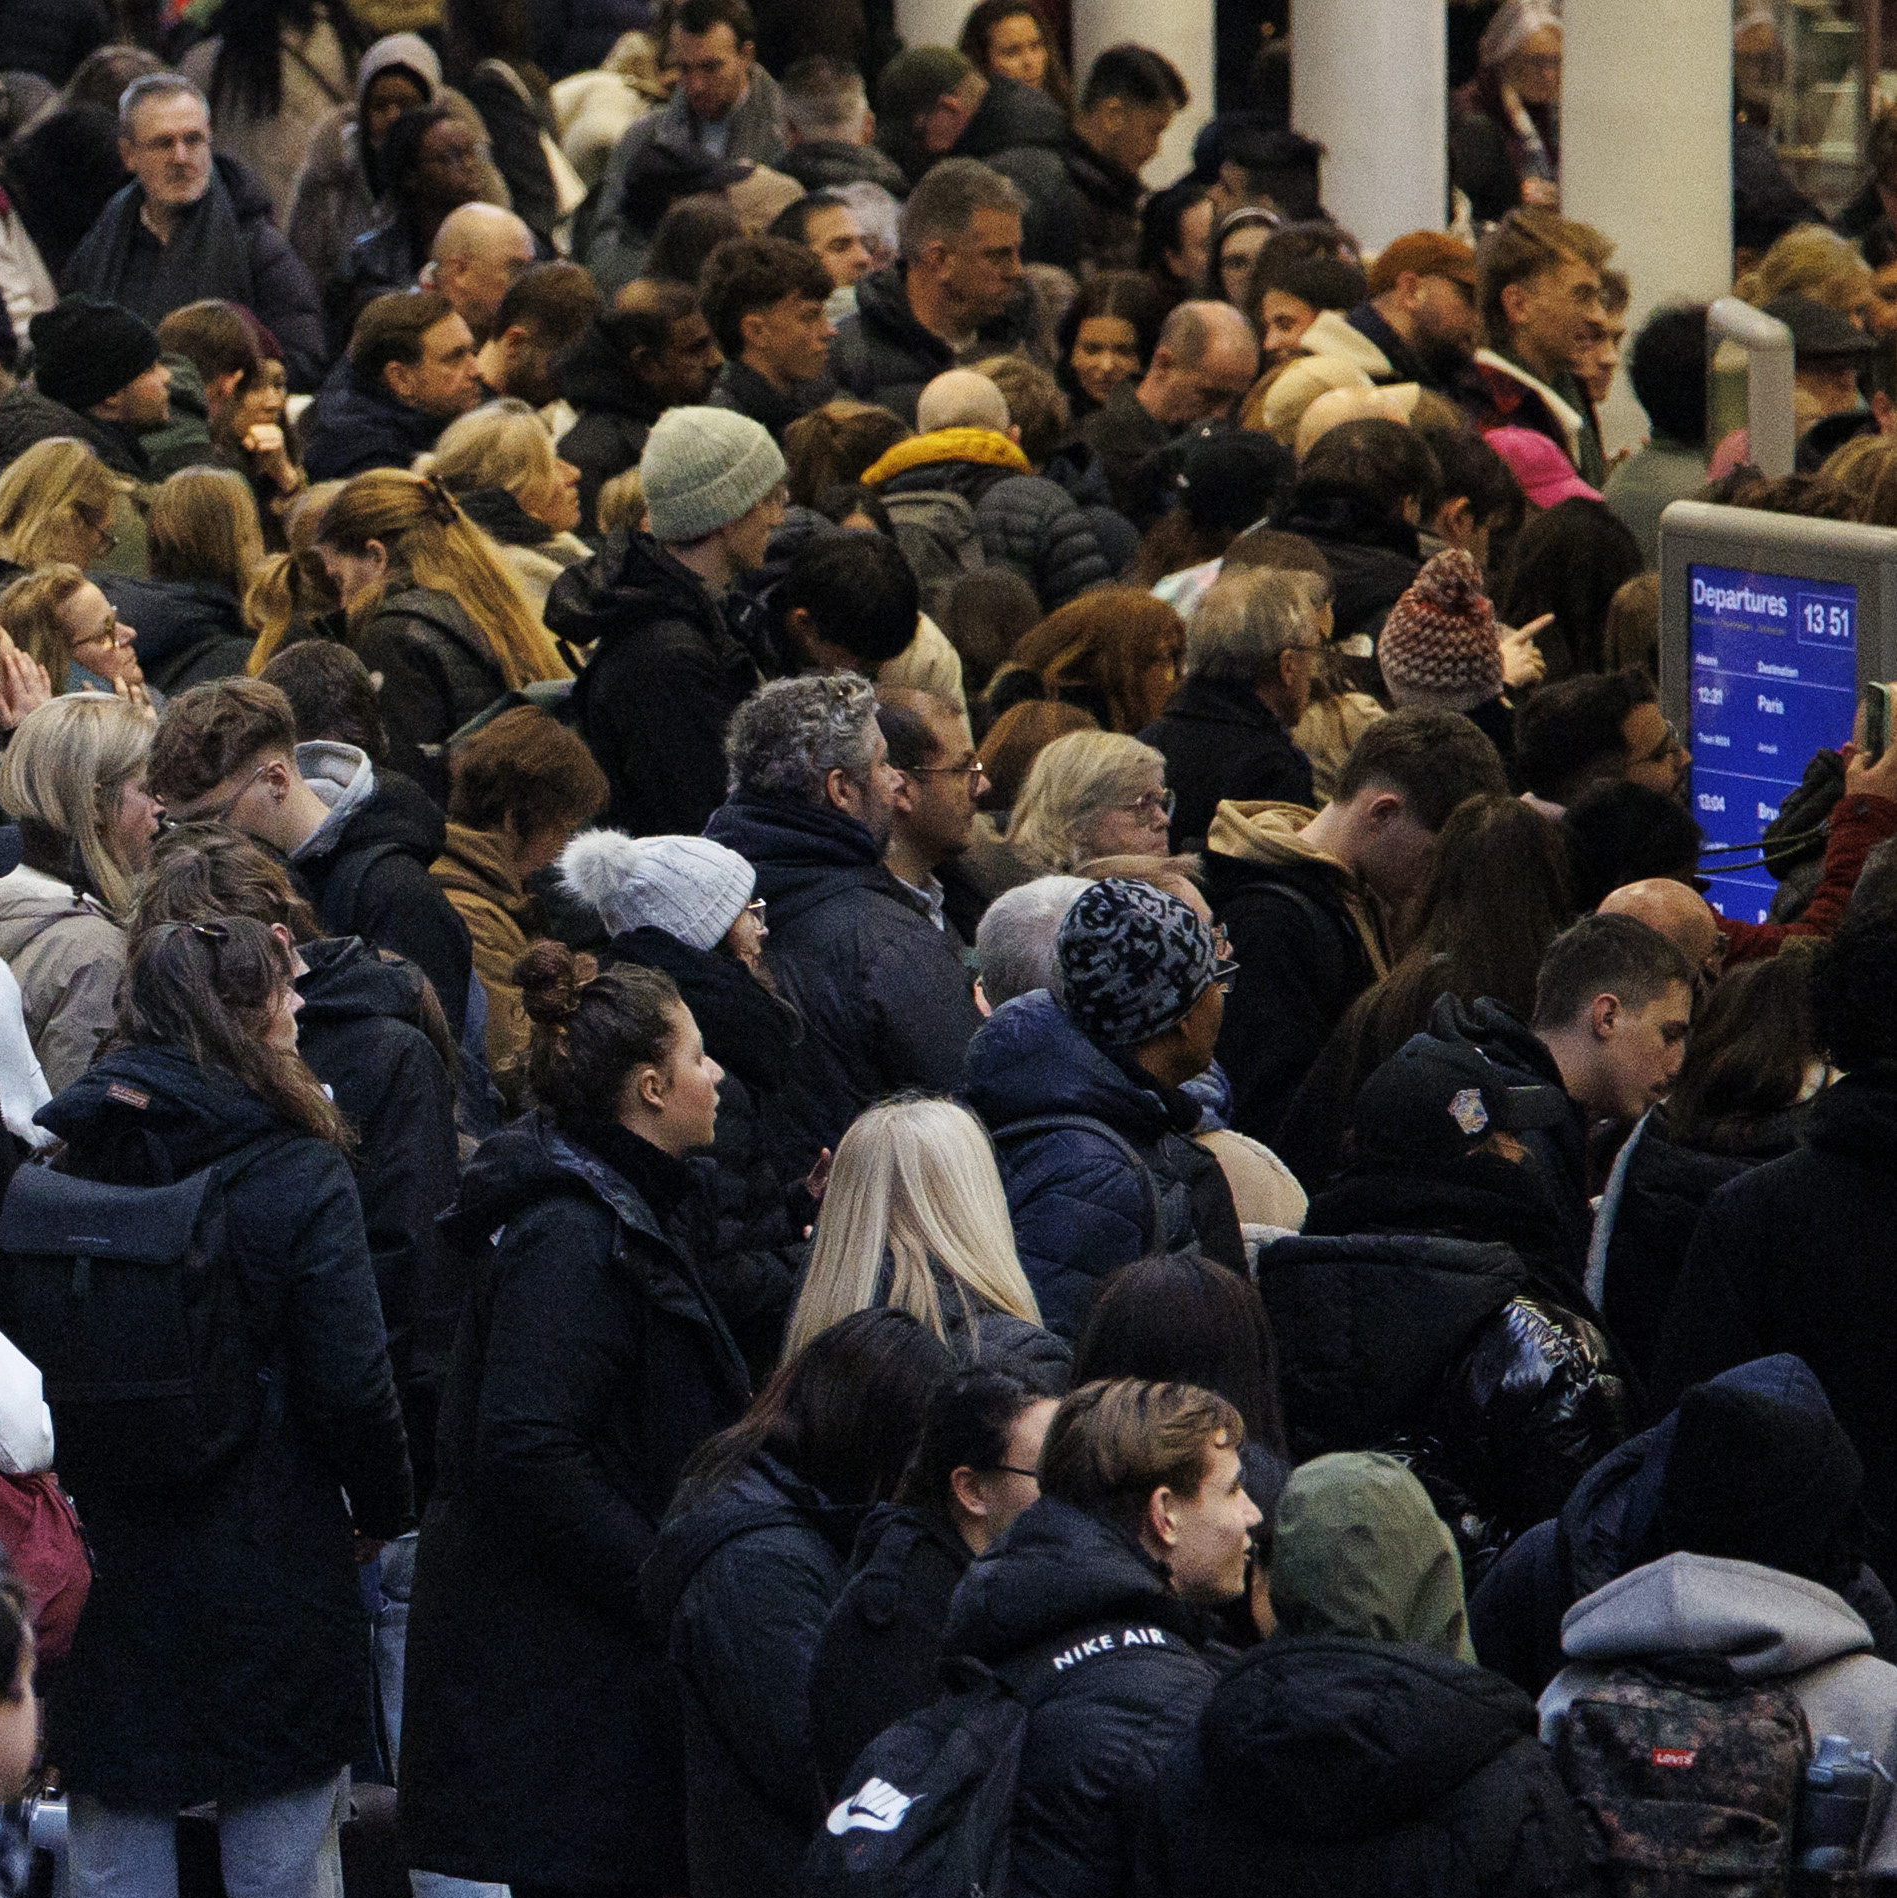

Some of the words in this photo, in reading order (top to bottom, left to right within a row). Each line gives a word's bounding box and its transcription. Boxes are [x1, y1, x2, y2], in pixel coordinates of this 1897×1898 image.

[1692, 578, 1788, 618] Departures
[1757, 694, 1785, 715] Paris
[1053, 1634, 1114, 1671] NIKE
[1123, 1628, 1166, 1647] AIR
